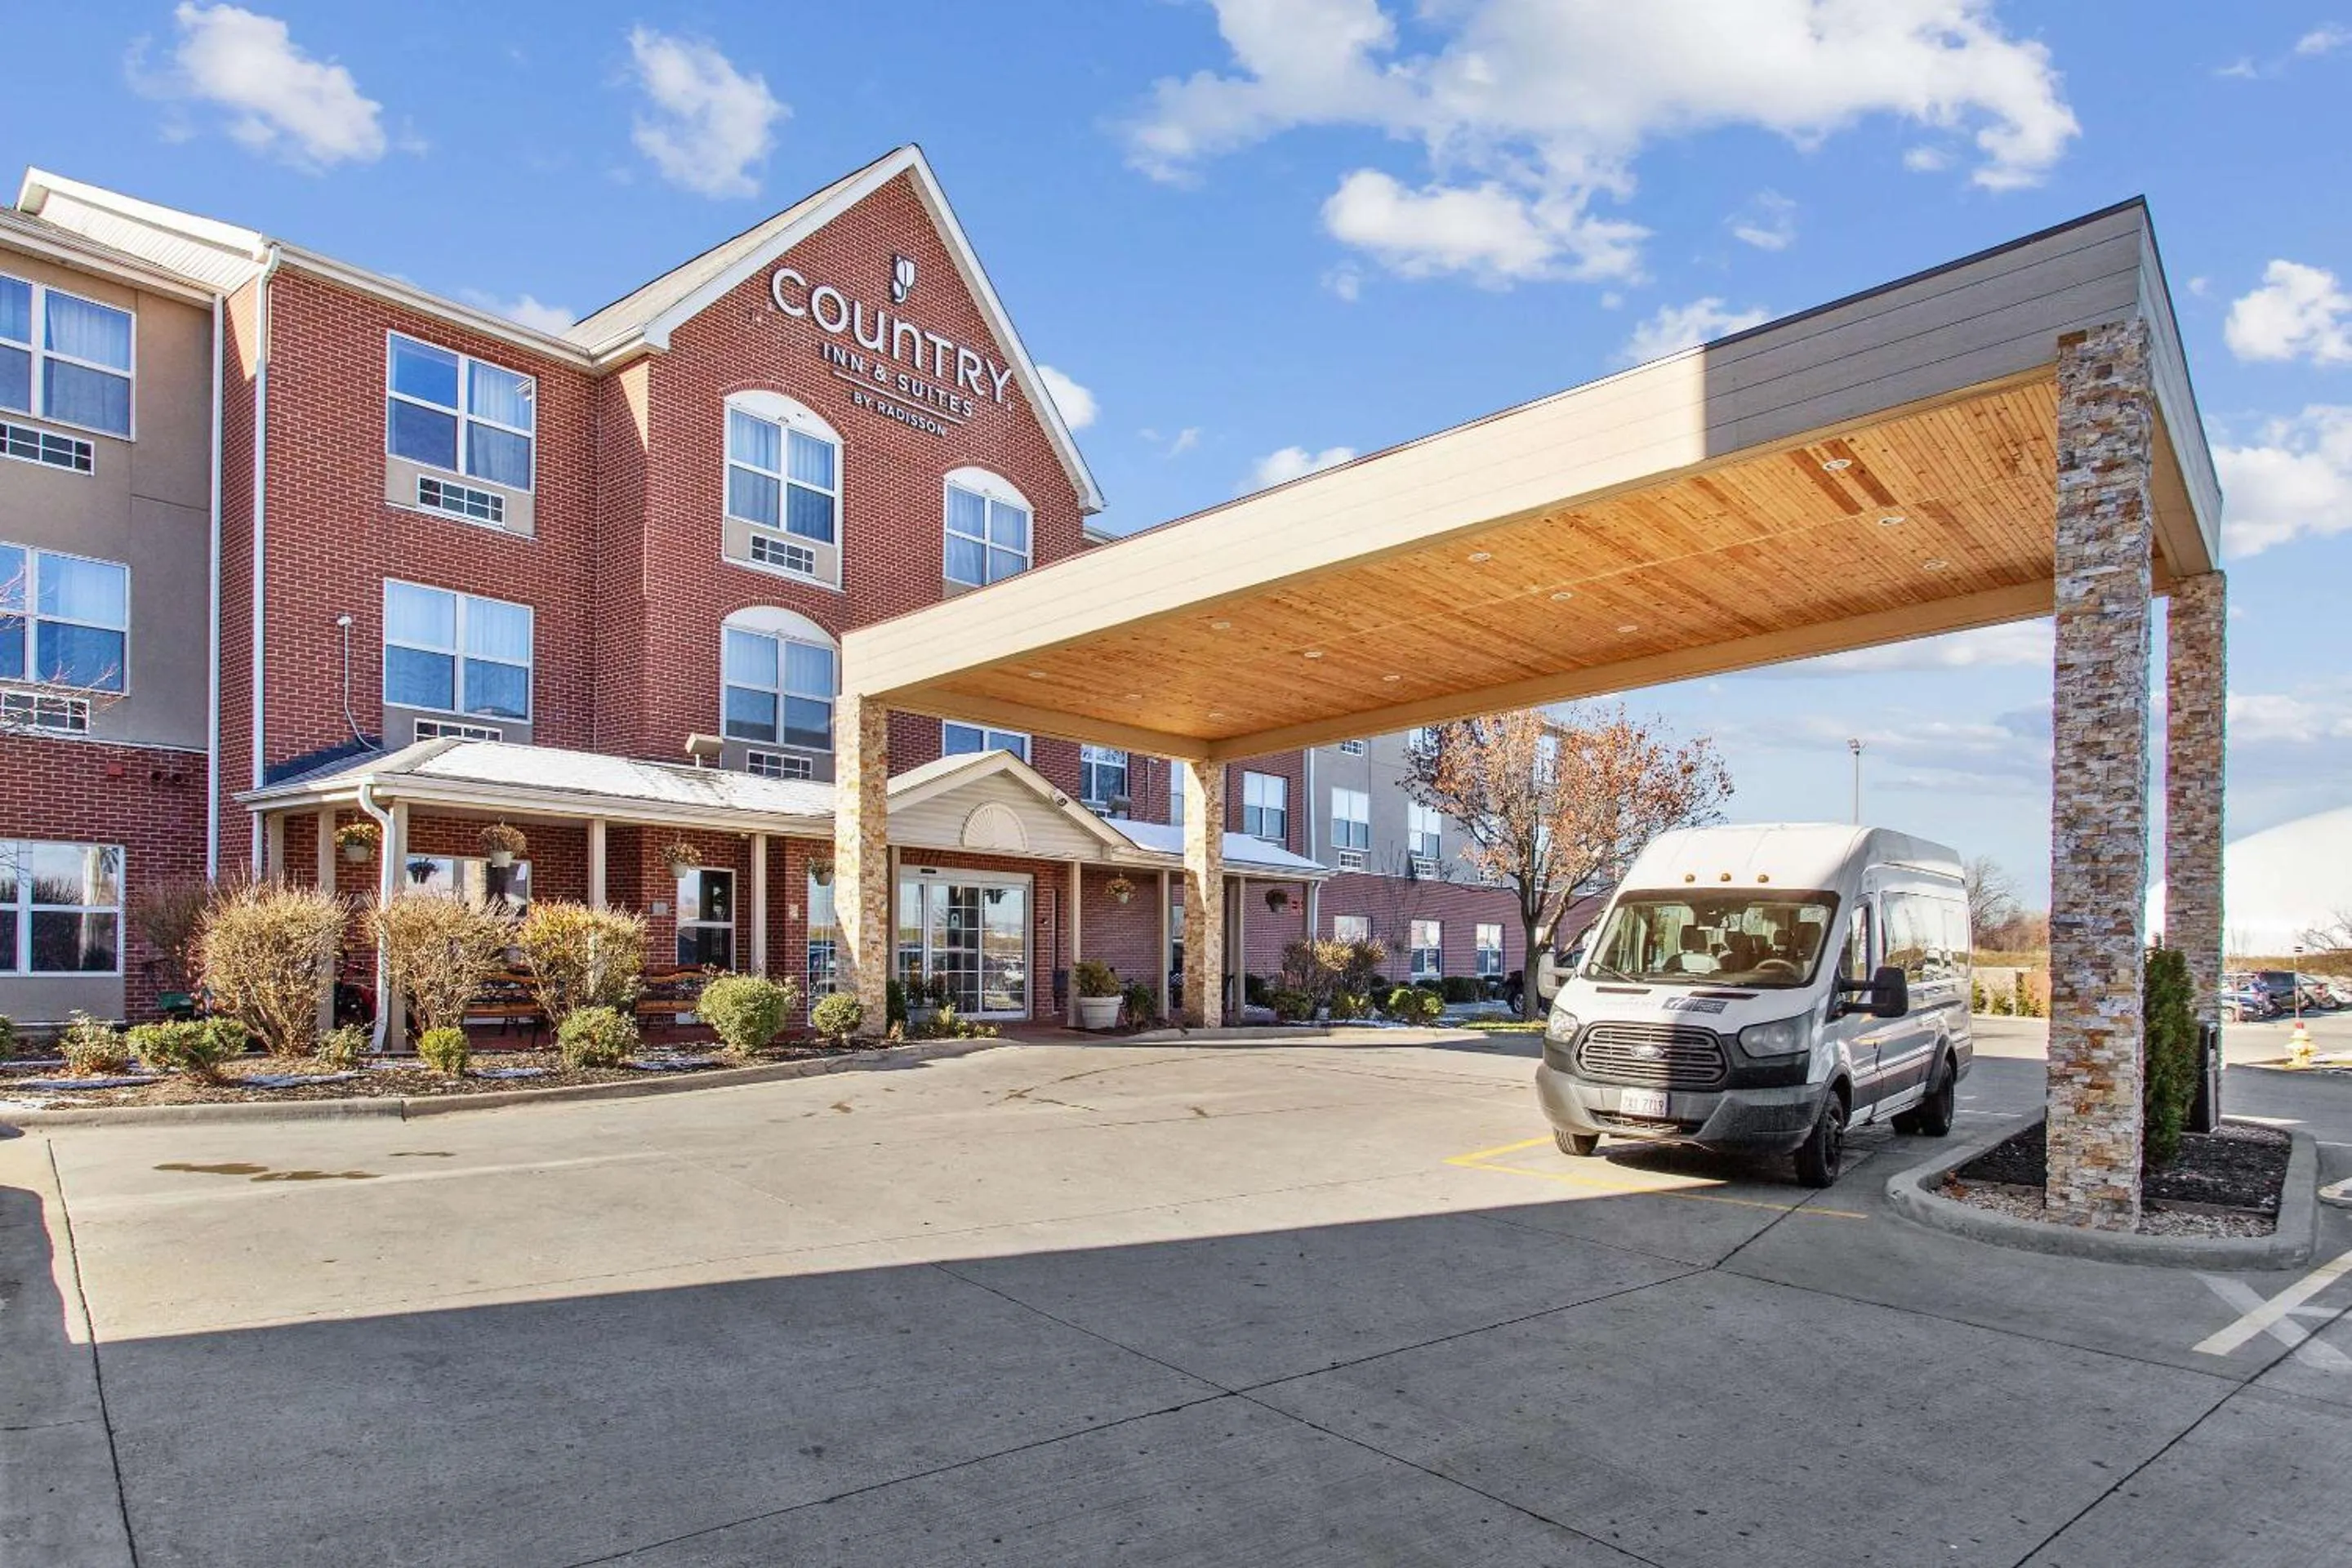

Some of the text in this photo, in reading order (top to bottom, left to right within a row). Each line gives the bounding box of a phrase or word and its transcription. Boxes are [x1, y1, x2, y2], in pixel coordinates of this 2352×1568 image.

[823, 342, 973, 418] INN & SUITES
[853, 391, 945, 436] BY RADISSON
